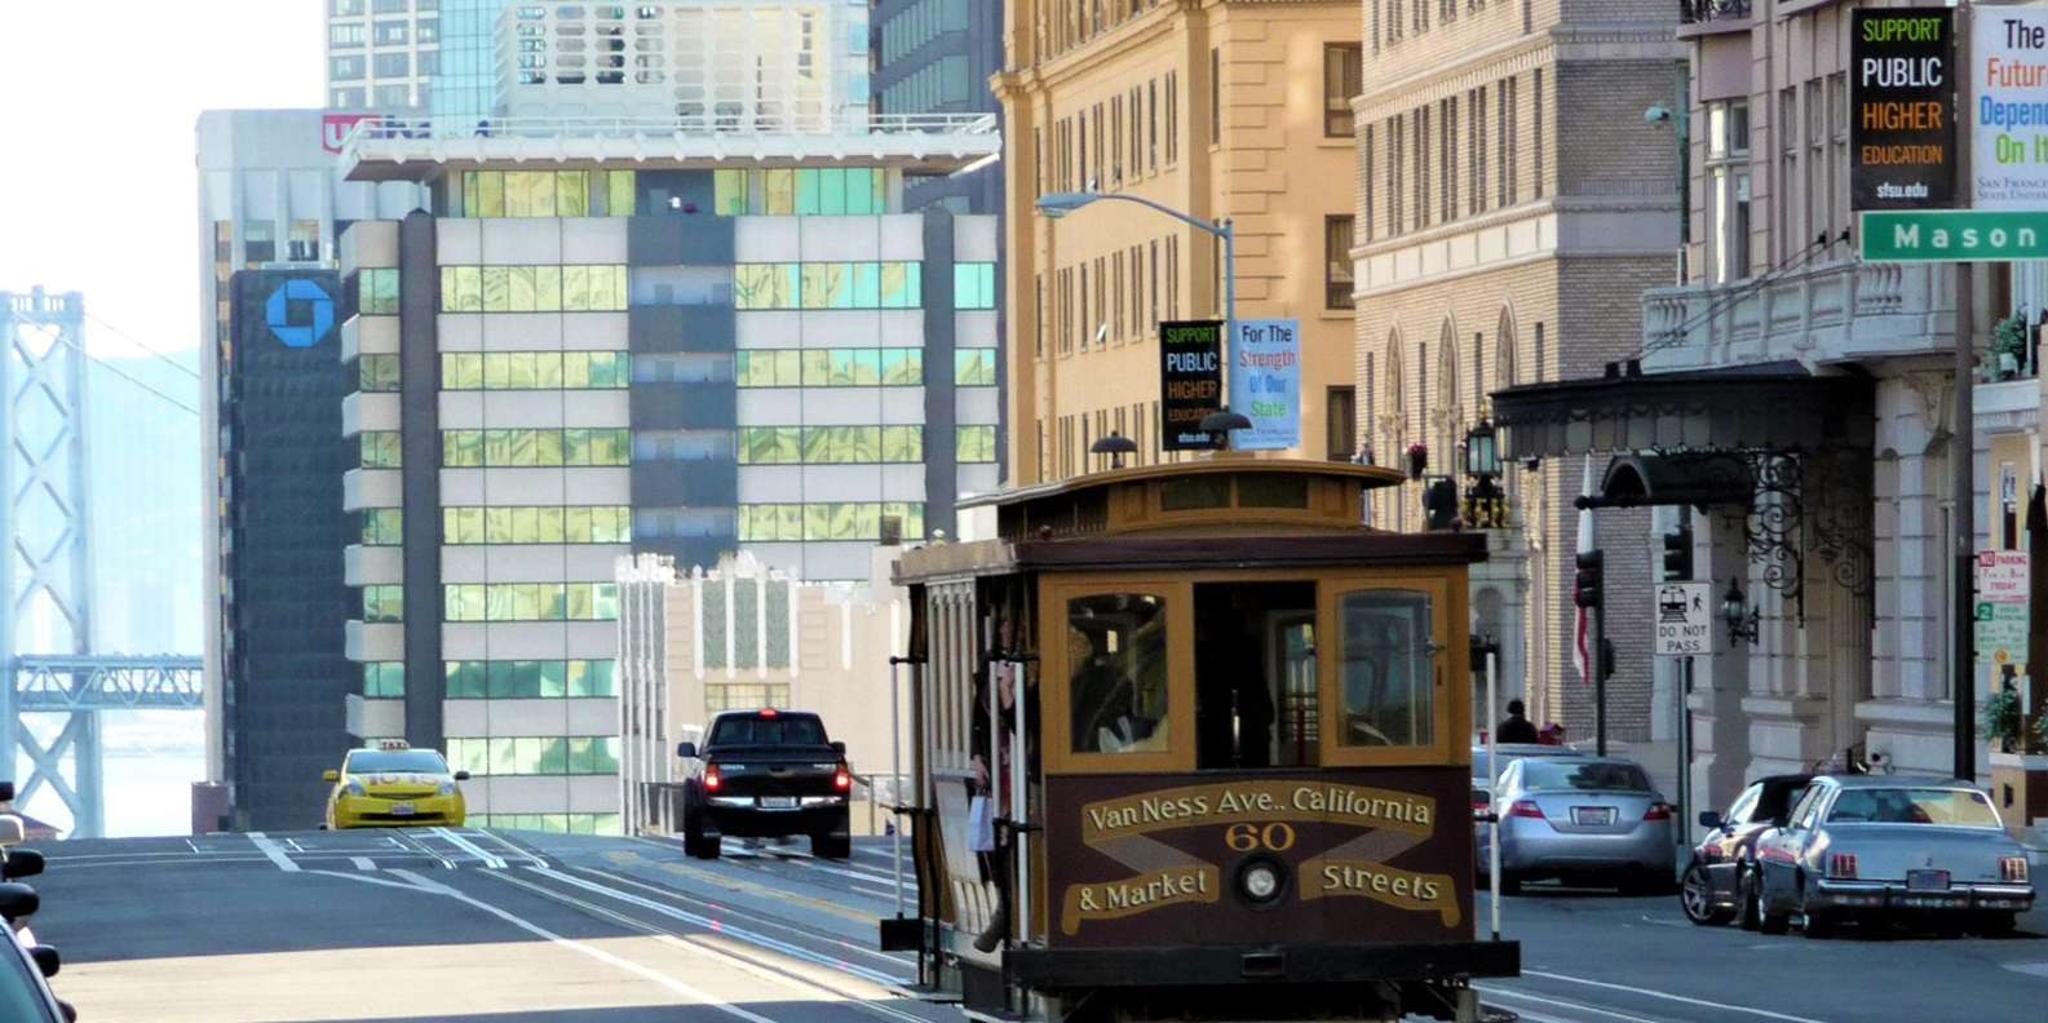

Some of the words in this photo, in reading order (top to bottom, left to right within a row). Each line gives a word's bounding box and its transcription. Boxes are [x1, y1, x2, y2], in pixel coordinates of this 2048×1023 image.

[1862, 19, 1942, 41] SUPPORT
[2003, 19, 2045, 49] The
[1862, 57, 1943, 87] PUBLIC
[1988, 57, 2048, 87] Futur
[1862, 102, 1943, 129] HIGHER
[1862, 146, 1943, 165] EDUCATION
[1996, 134, 2025, 164] On
[1877, 182, 1928, 198] sfsu.edu
[1894, 223, 2036, 249] Mason
[1167, 328, 1217, 343] SUPPORT
[1242, 326, 1264, 343] For
[1269, 325, 1293, 342] The
[1167, 352, 1217, 372] PUBLIC
[1240, 351, 1296, 371] Strength
[1168, 380, 1217, 399] HIGHER
[1252, 400, 1287, 418] State
[1659, 626, 1676, 637] DO
[1683, 625, 1707, 637] NOT
[1667, 641, 1700, 651] PASS
[1089, 806, 1139, 832] Van
[1141, 796, 1209, 822] Ness
[1292, 787, 1430, 823] California
[1225, 822, 1296, 851] 60
[1079, 887, 1100, 911] &
[1106, 869, 1207, 910] Market
[1323, 865, 1439, 900] Streets
